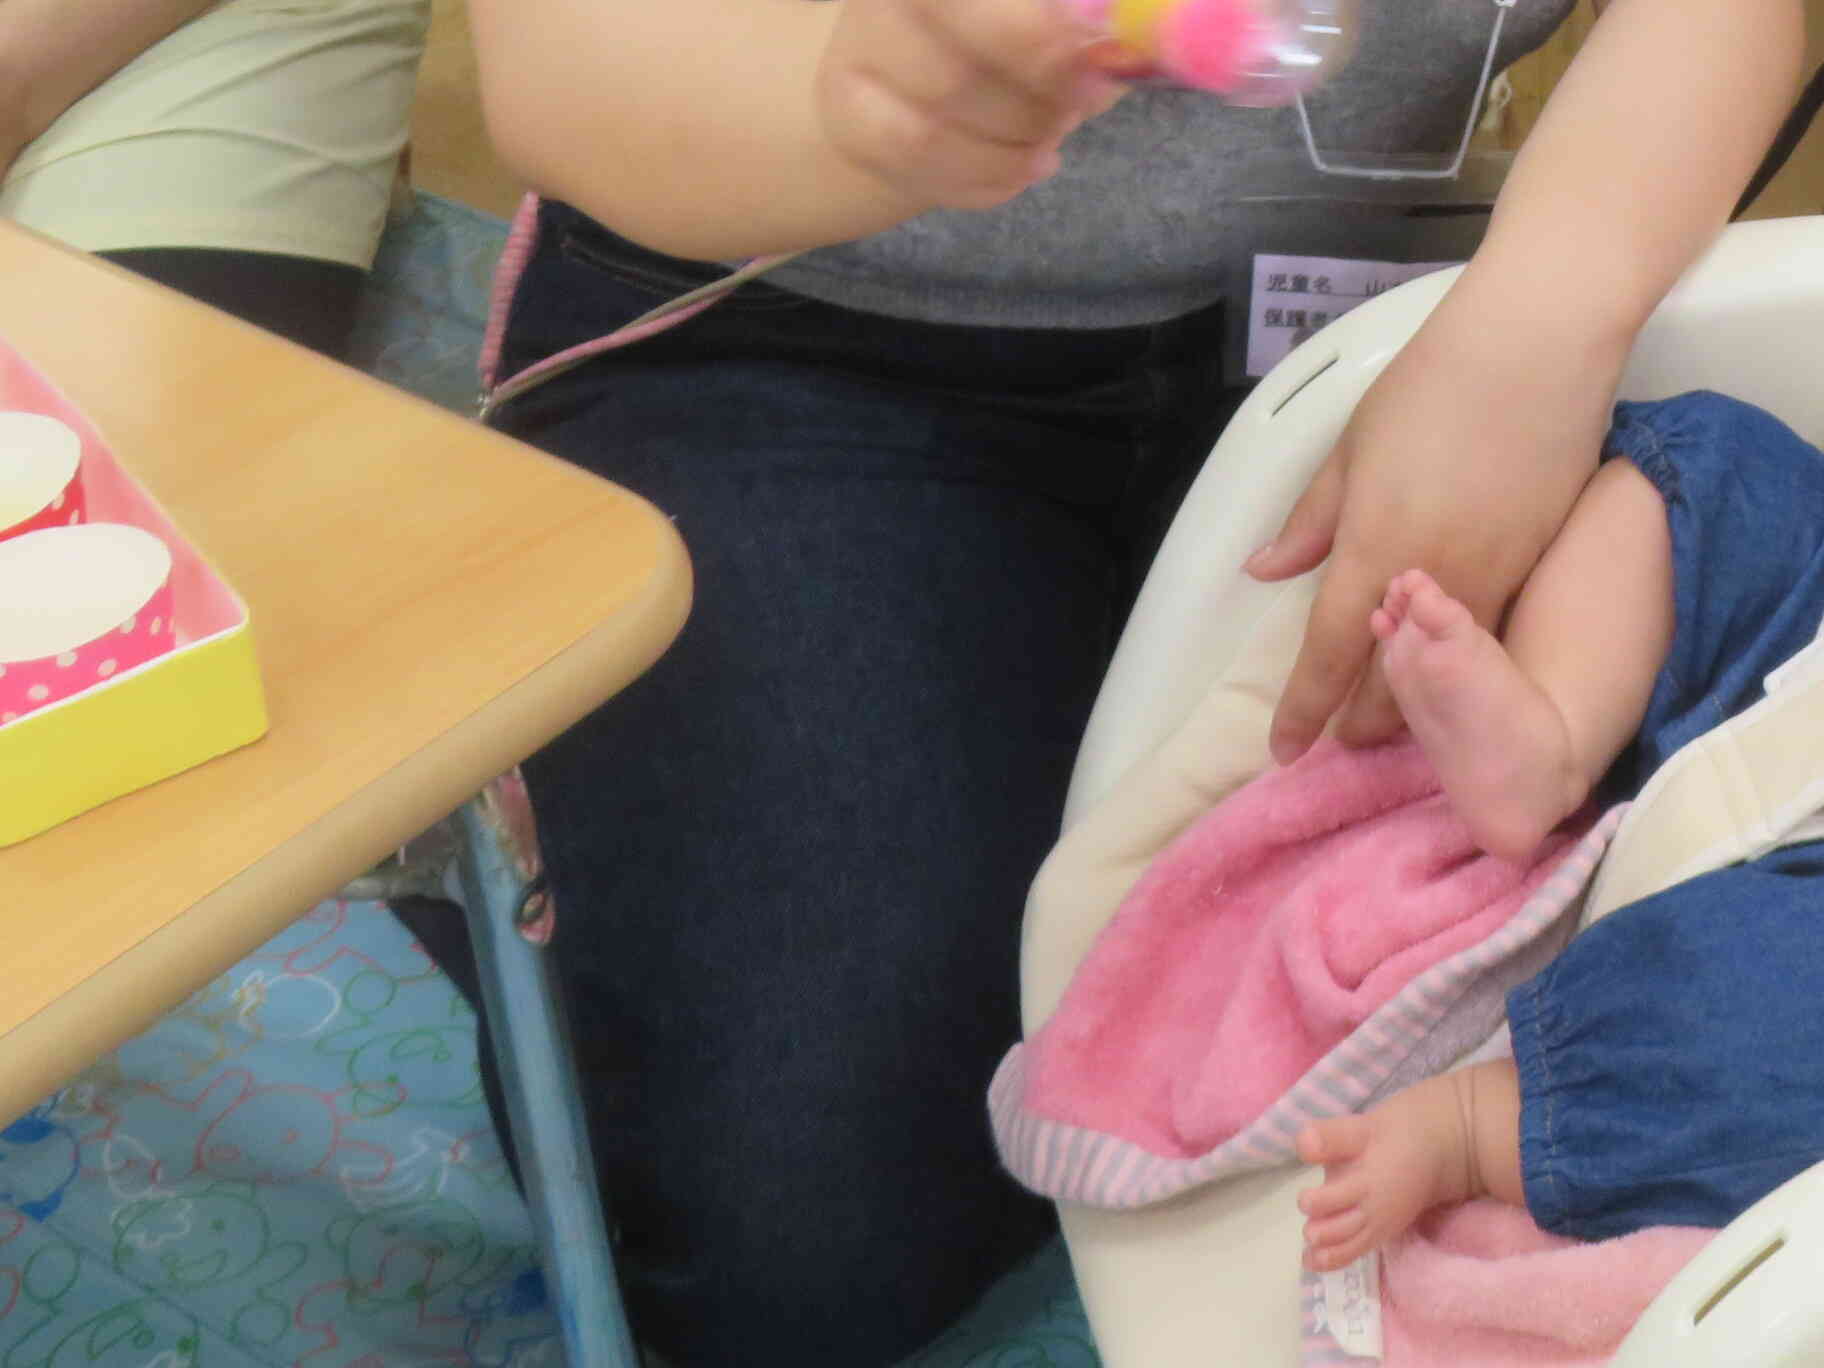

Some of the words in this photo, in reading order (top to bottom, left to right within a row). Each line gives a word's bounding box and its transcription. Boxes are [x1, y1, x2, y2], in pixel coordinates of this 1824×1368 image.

[1265, 273, 1333, 295] 児童名
[1263, 307, 1343, 329] 保護者
